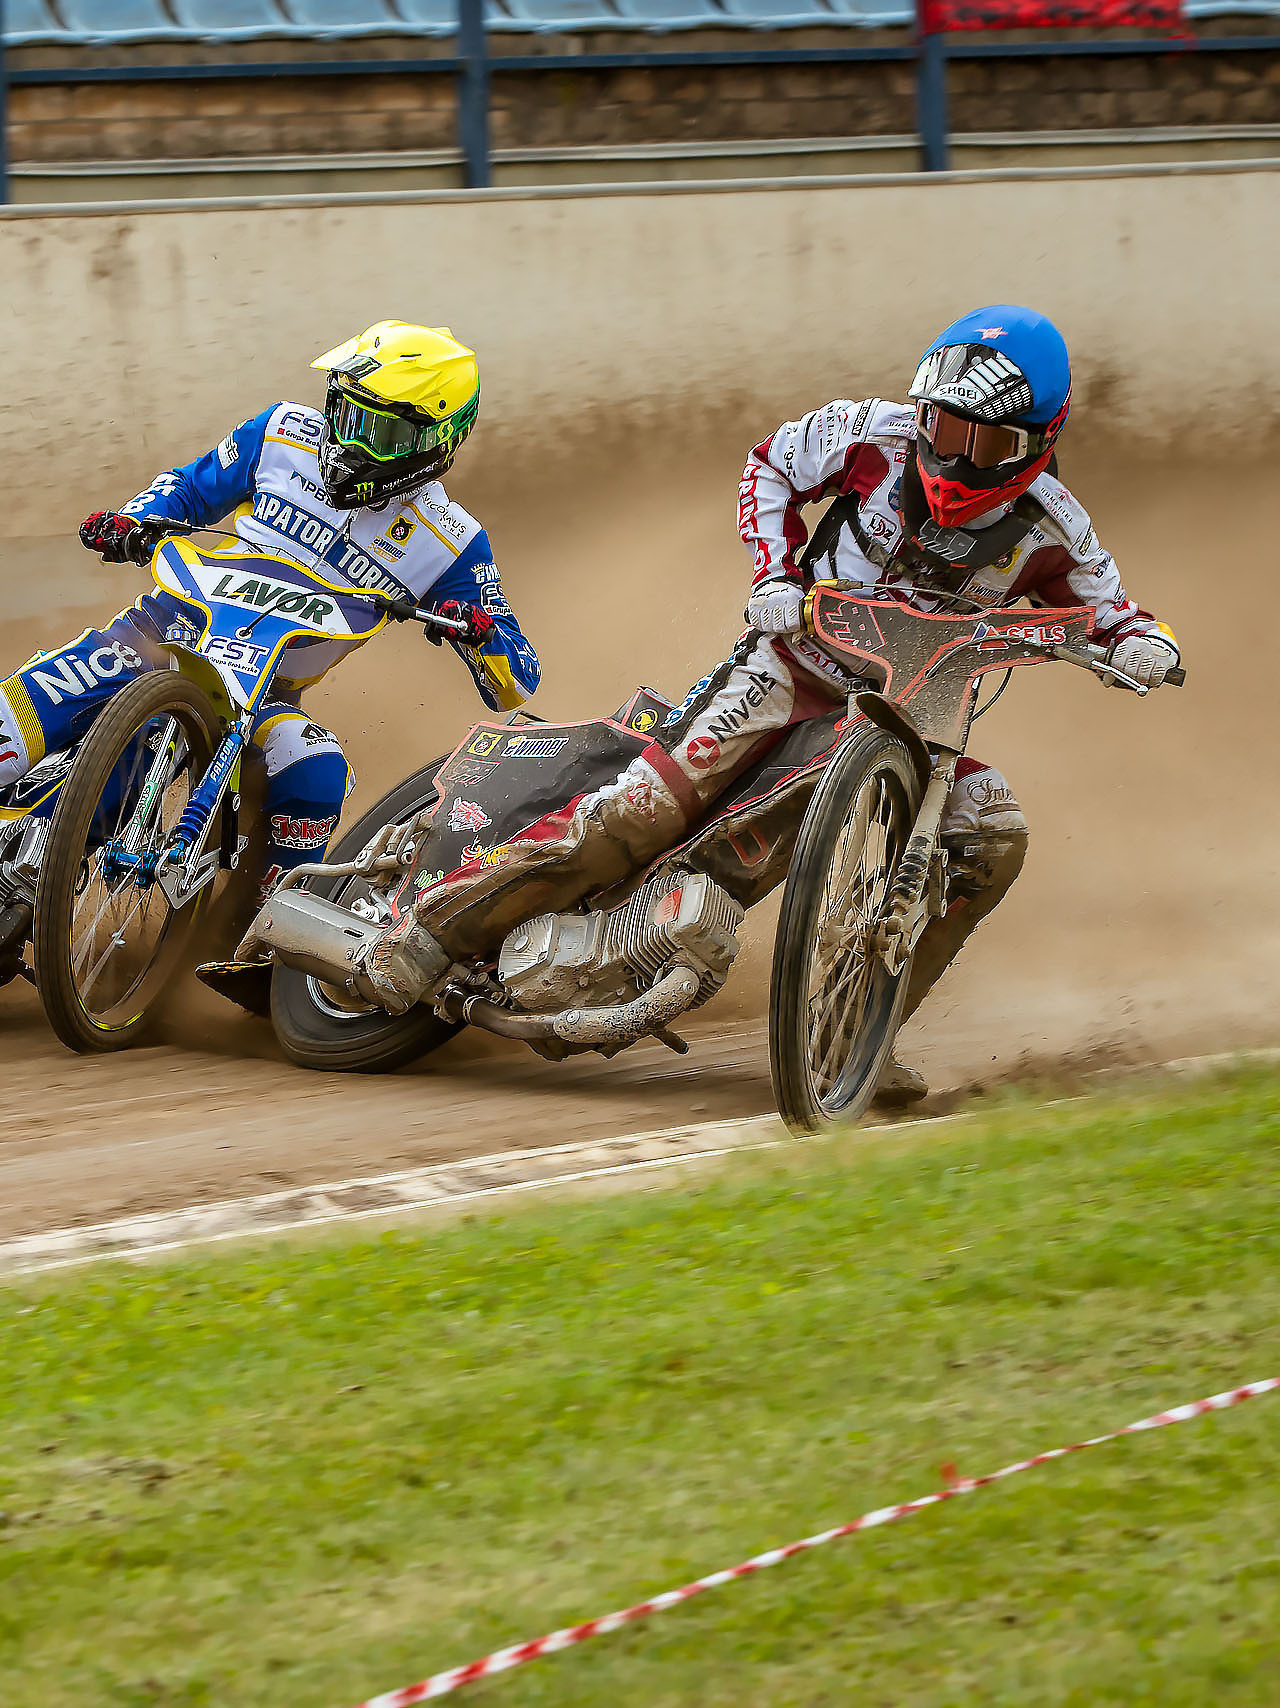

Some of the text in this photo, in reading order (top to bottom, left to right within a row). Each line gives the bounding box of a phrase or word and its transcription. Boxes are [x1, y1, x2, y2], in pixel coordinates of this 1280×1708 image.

[280, 411, 324, 437] FS
[254, 493, 335, 554] APATOR
[211, 574, 334, 626] LAVOR
[30, 640, 143, 706] Nice
[206, 637, 271, 666] FST
[208, 737, 236, 783] FALCON
[271, 815, 338, 839] Joker
